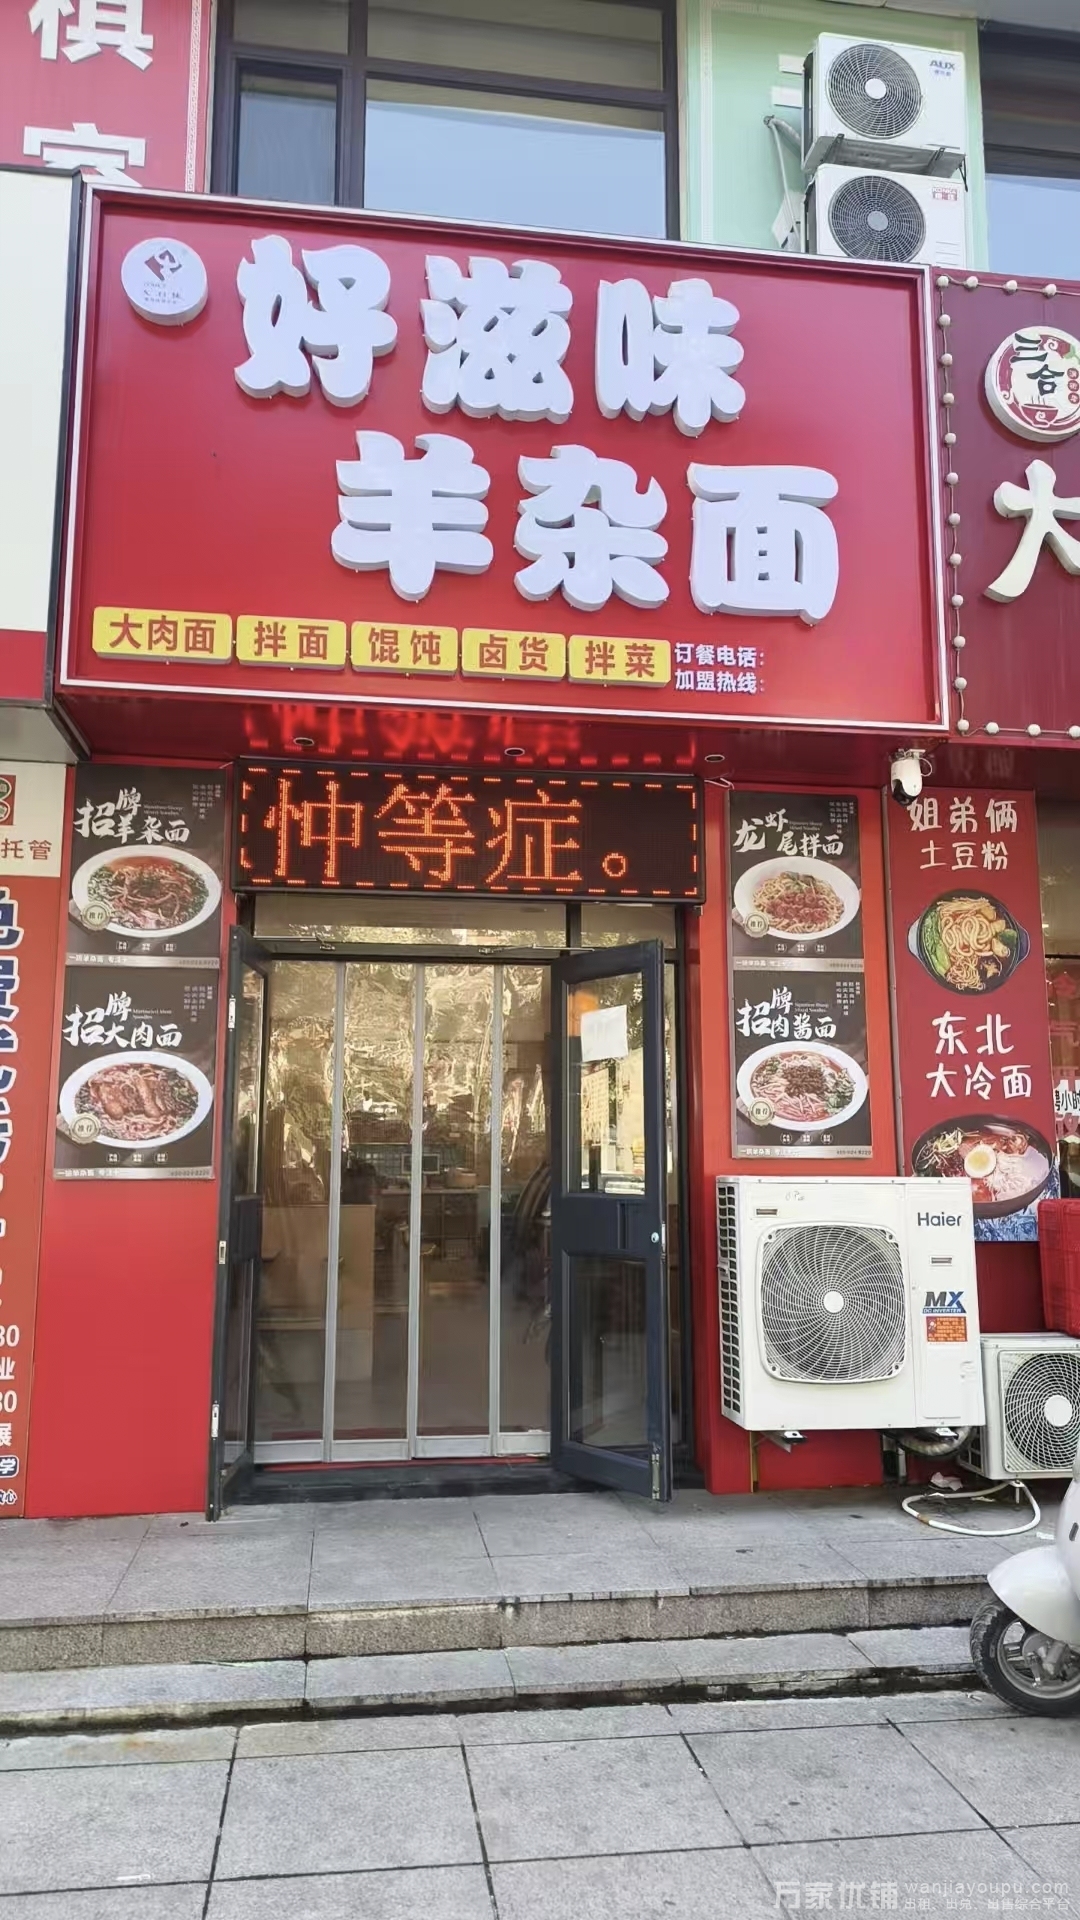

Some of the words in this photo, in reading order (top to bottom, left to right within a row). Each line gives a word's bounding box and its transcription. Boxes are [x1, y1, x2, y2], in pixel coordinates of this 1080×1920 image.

[930, 60, 955, 70] AUX
[234, 235, 746, 436] 好滋味
[1010, 333, 1065, 397] 三合
[331, 430, 839, 626] 羊杂面
[983, 459, 1080, 604] 大
[109, 612, 217, 654] 大肉面
[254, 620, 329, 660] 拌面
[368, 627, 442, 667] 馄饨
[479, 634, 549, 672] 卤货
[584, 640, 656, 678] 拌菜
[907, 796, 1018, 834] 姐弟俩
[1, 838, 52, 861] 托管
[920, 840, 1009, 871] 土豆粉
[932, 1010, 1015, 1055] 东北
[926, 1061, 1032, 1100] 大冷面
[917, 1212, 962, 1227] Haier
[924, 1291, 966, 1307] MX
